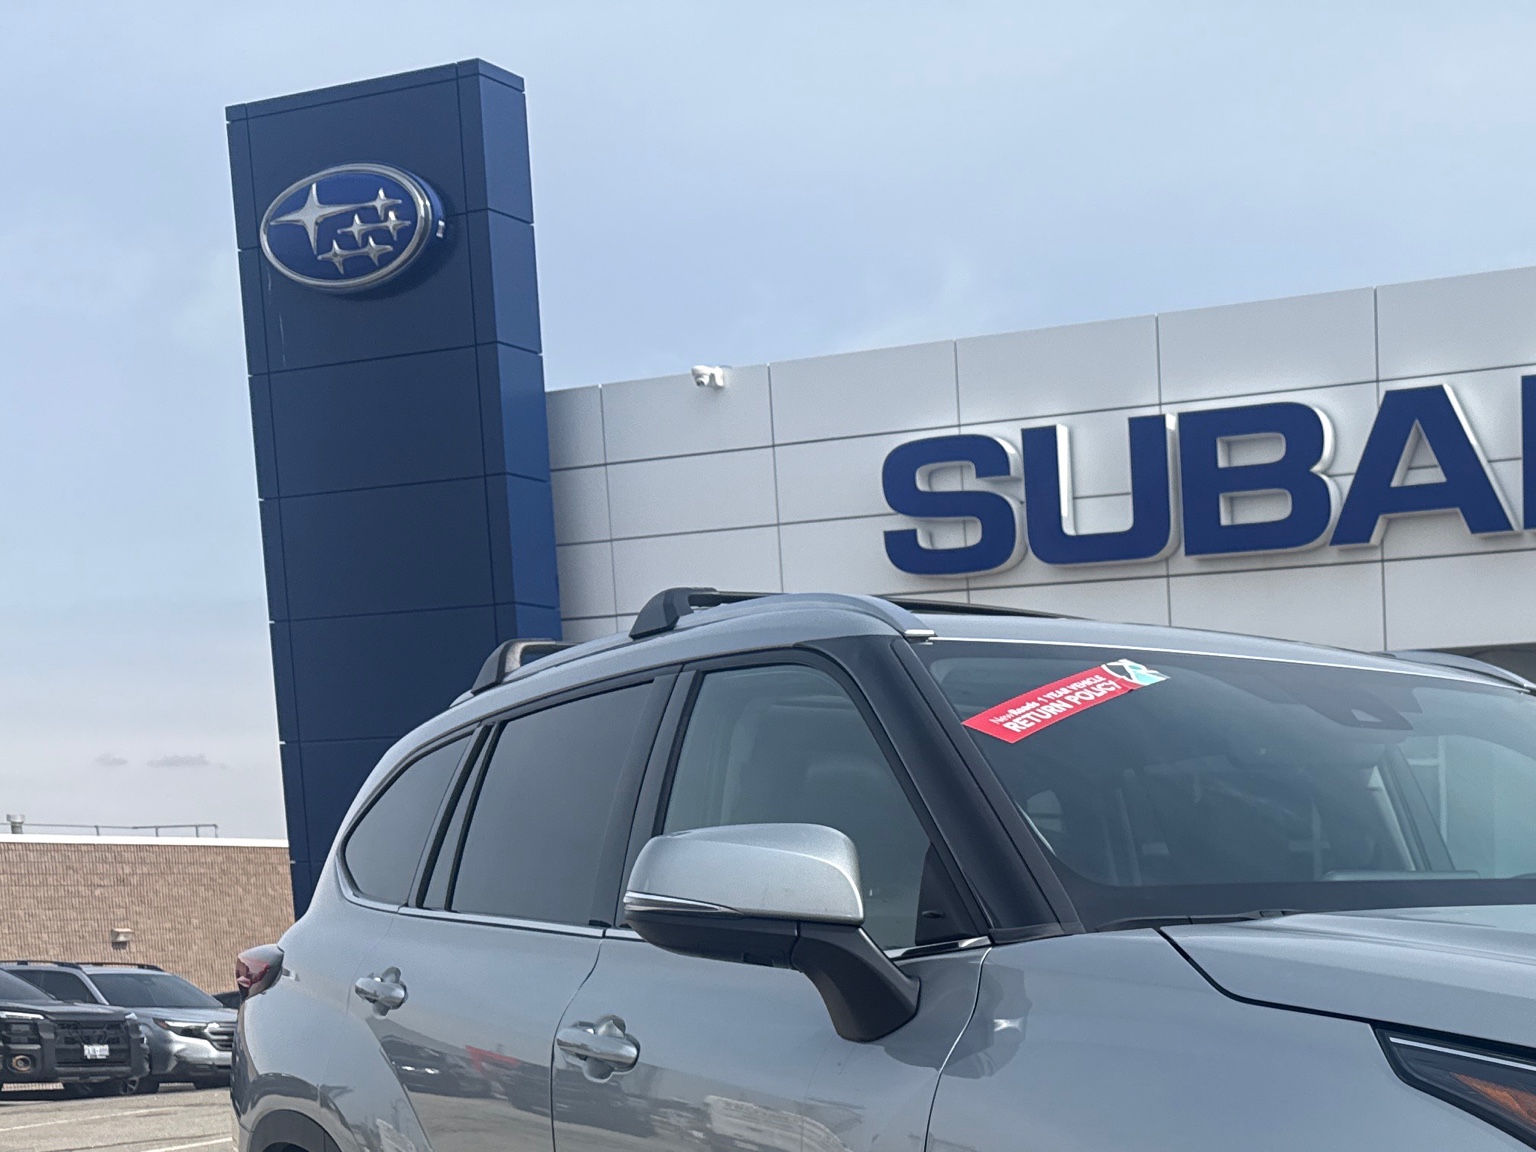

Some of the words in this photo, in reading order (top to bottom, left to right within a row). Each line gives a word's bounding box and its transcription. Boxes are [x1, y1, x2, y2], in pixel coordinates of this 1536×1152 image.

[1002, 699, 1074, 733] RETURN
[1064, 680, 1122, 706] POLICY
[1042, 687, 1073, 700] YEAR
[1066, 674, 1107, 691] VEHICLE
